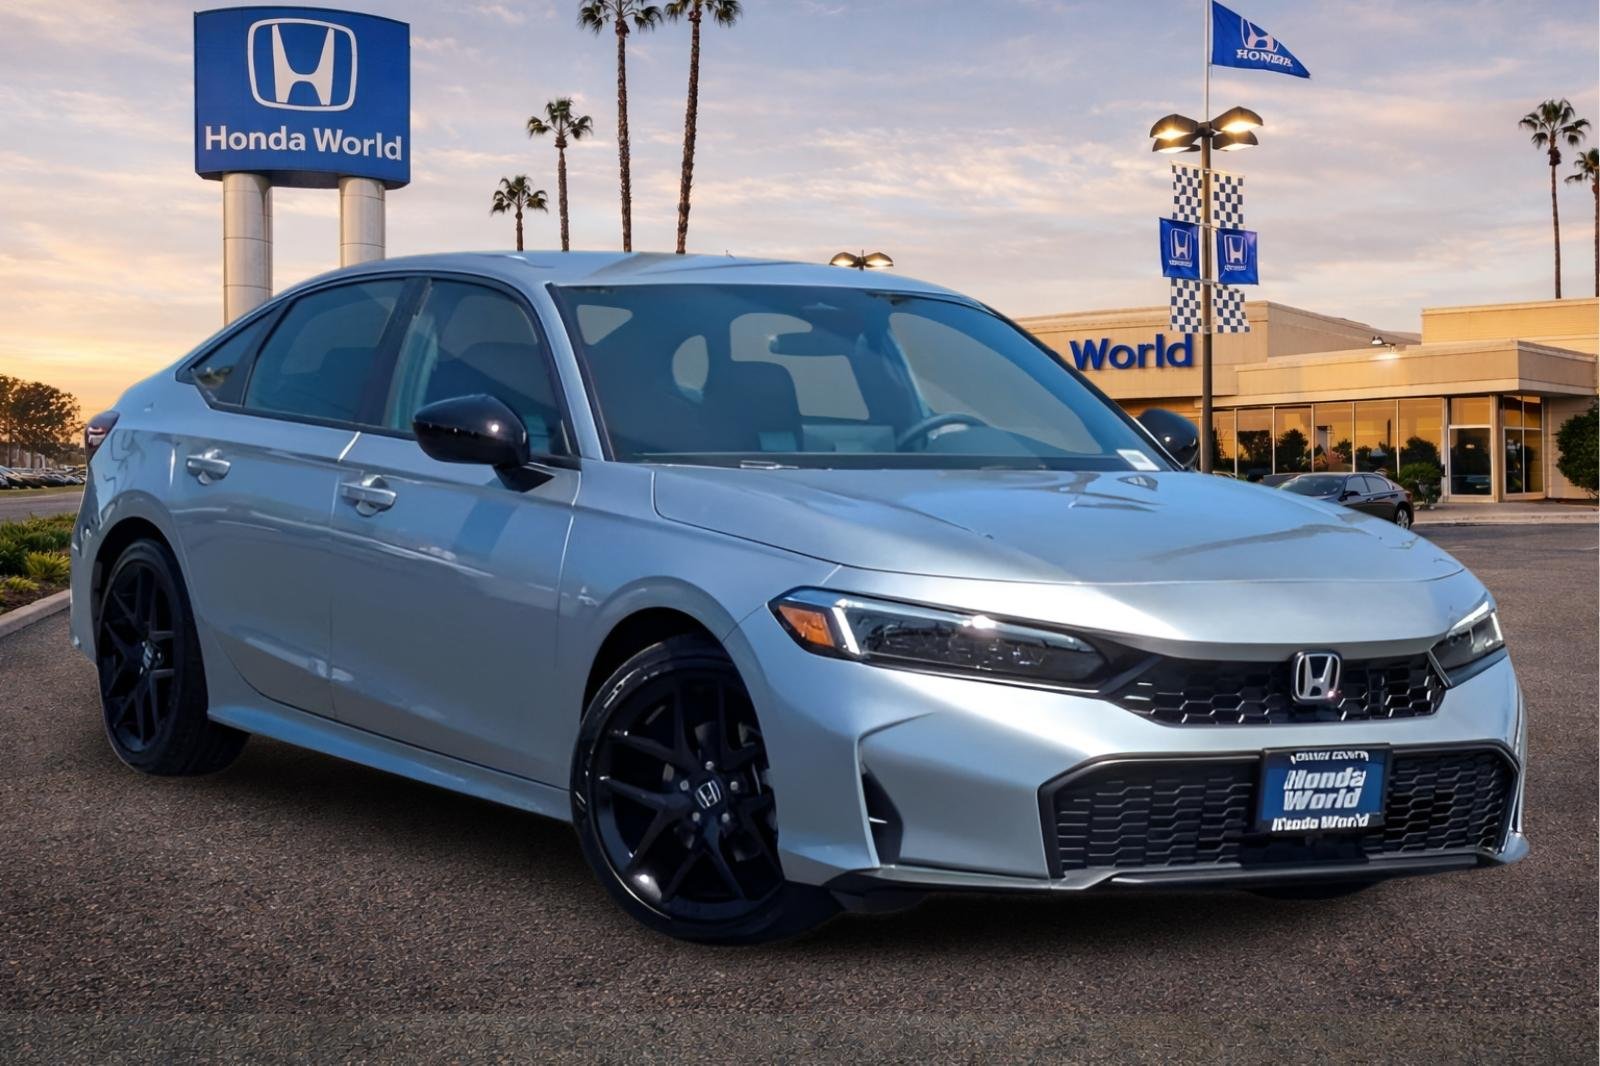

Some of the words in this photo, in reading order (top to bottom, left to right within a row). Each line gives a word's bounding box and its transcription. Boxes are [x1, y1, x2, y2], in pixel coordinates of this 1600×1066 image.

[205, 125, 306, 151] Honda
[312, 127, 402, 160] World
[1069, 333, 1194, 371] World
[1283, 766, 1367, 790] Honda
[1283, 787, 1363, 811] World
